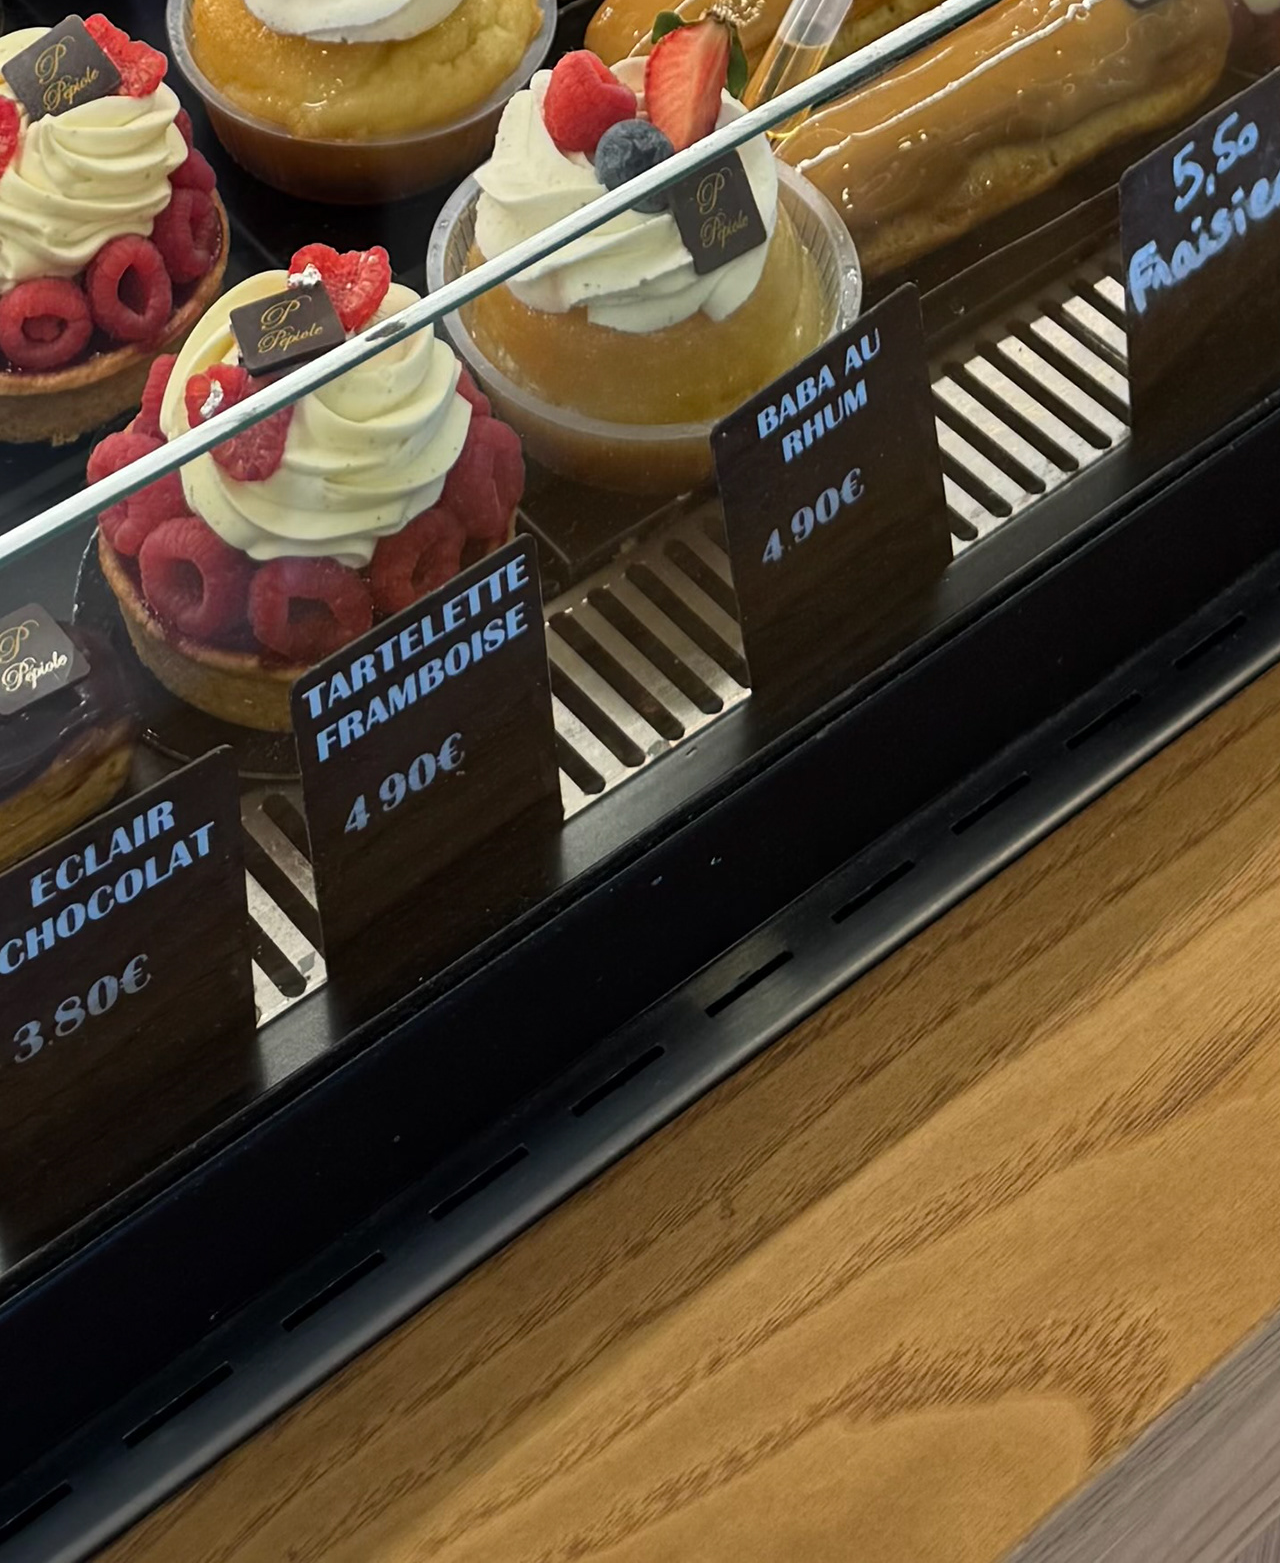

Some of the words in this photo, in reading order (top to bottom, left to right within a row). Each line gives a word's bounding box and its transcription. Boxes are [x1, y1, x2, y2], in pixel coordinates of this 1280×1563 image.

[35, 34, 75, 84] P
[257, 322, 324, 354] Pépiole
[260, 294, 312, 331] P
[757, 364, 835, 439] BABA
[845, 327, 881, 376] AU
[781, 379, 868, 464] RHUM
[1, 651, 68, 692] Pépiole
[301, 554, 529, 719] TARTELETTE
[316, 602, 528, 763] FRAMBOISE
[30, 800, 175, 908] ECLAIR
